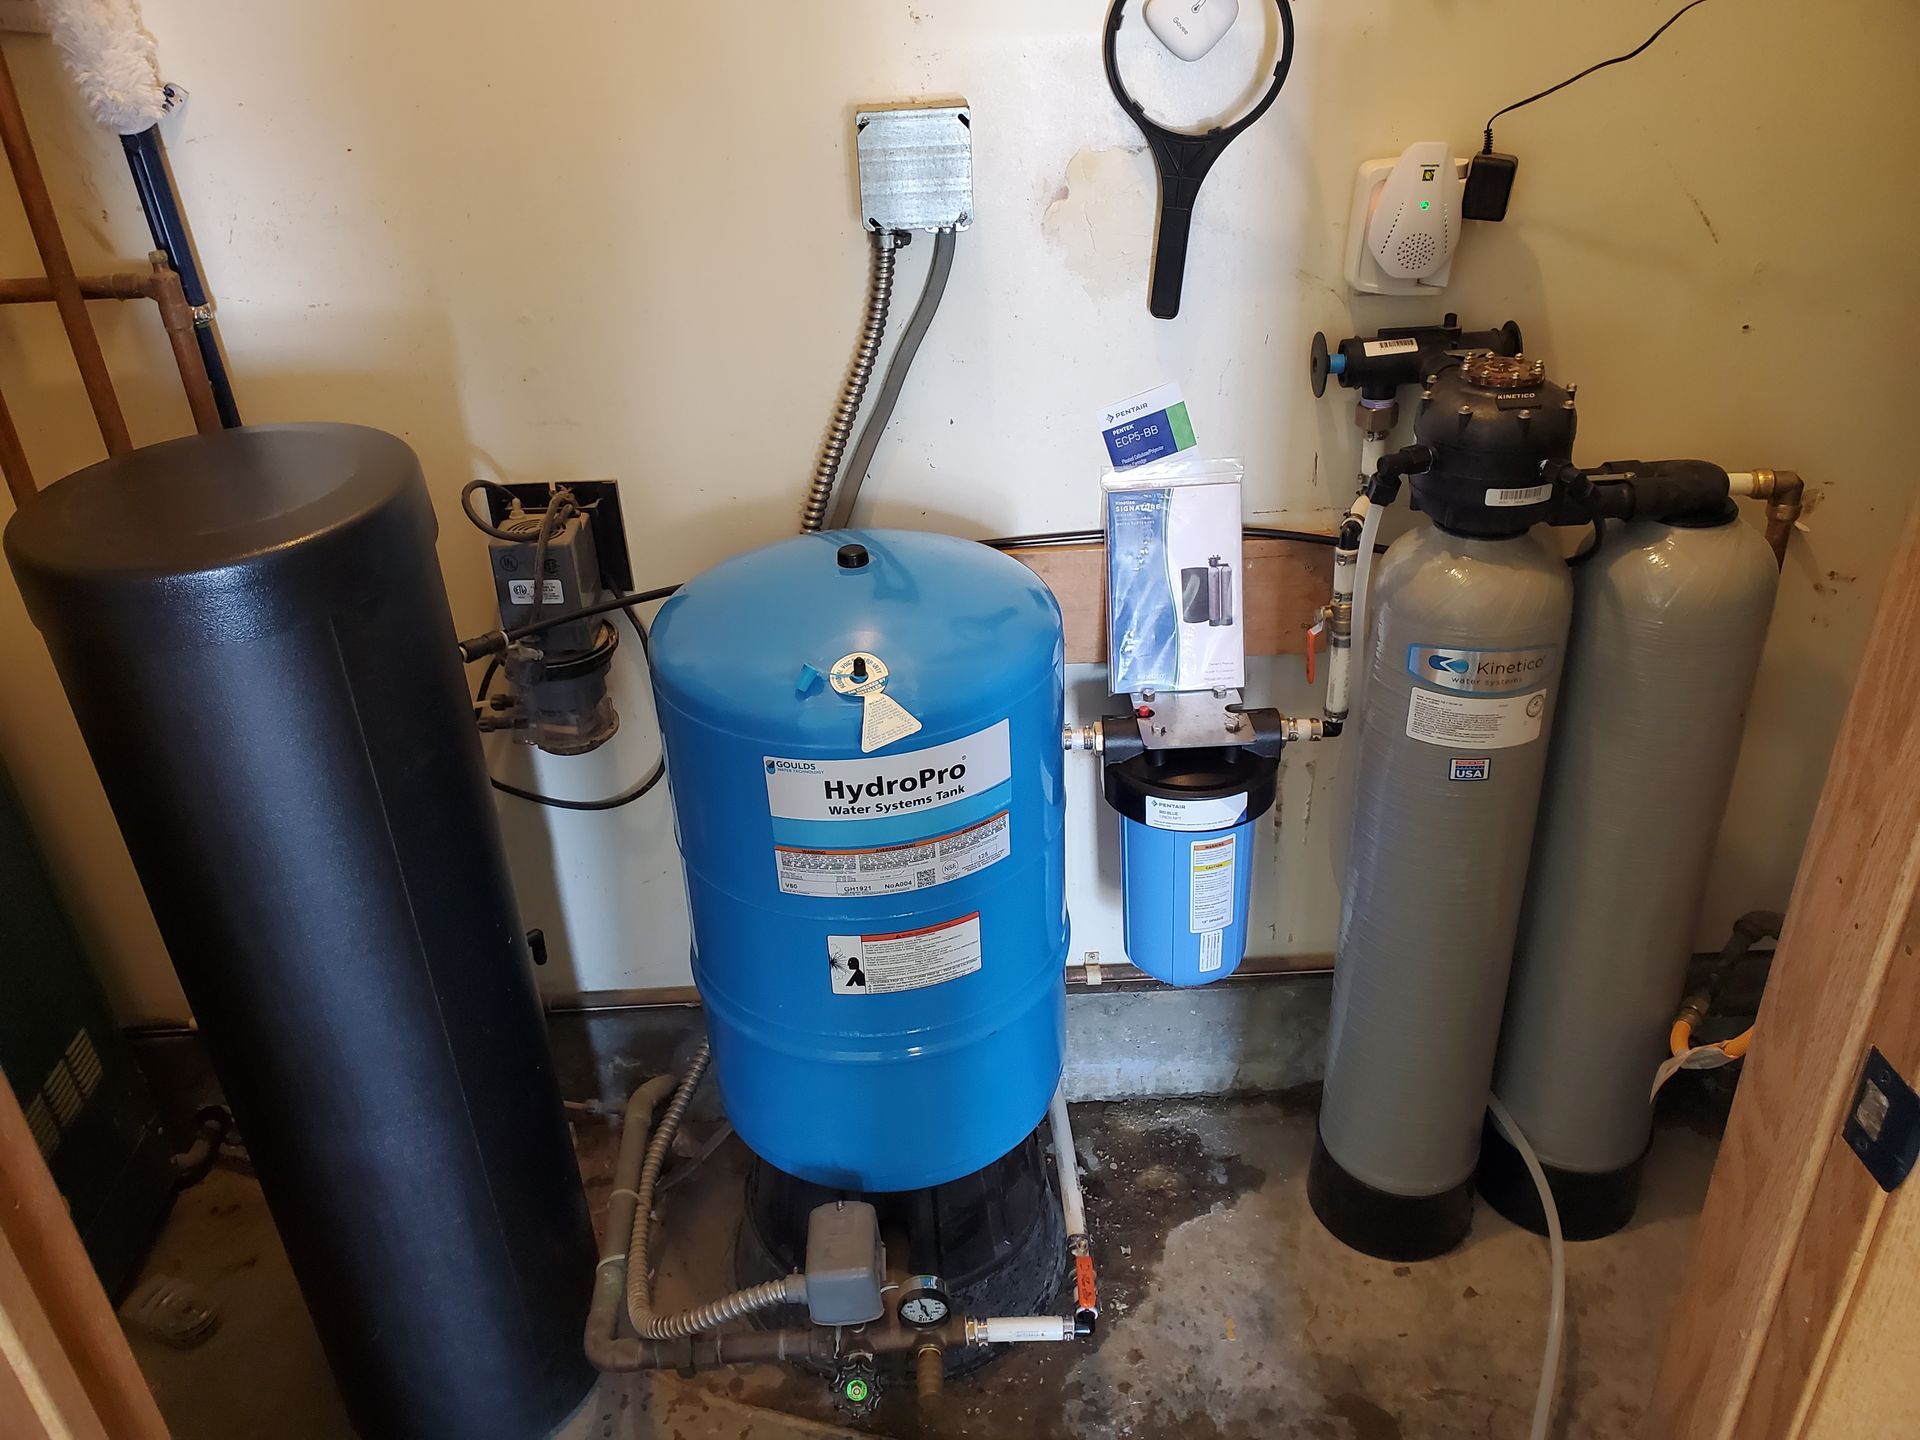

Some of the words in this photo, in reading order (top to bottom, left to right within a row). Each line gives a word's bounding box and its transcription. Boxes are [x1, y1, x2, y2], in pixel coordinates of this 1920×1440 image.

[1172, 16, 1189, 35] Govee
[1497, 392, 1536, 400] KINETICO
[1115, 402, 1148, 419] PENTAIR
[1112, 423, 1135, 436] PENTEK
[1114, 425, 1159, 448] ECP5-BB
[1476, 658, 1544, 675] Kinetico
[1451, 677, 1480, 685] water
[776, 760, 816, 770] GOULDS
[1456, 770, 1482, 778] USA
[824, 763, 966, 805] HydroPro
[828, 805, 871, 815] Water
[875, 794, 933, 814] Systems
[936, 784, 966, 801] Tank
[944, 862, 957, 872] NSF
